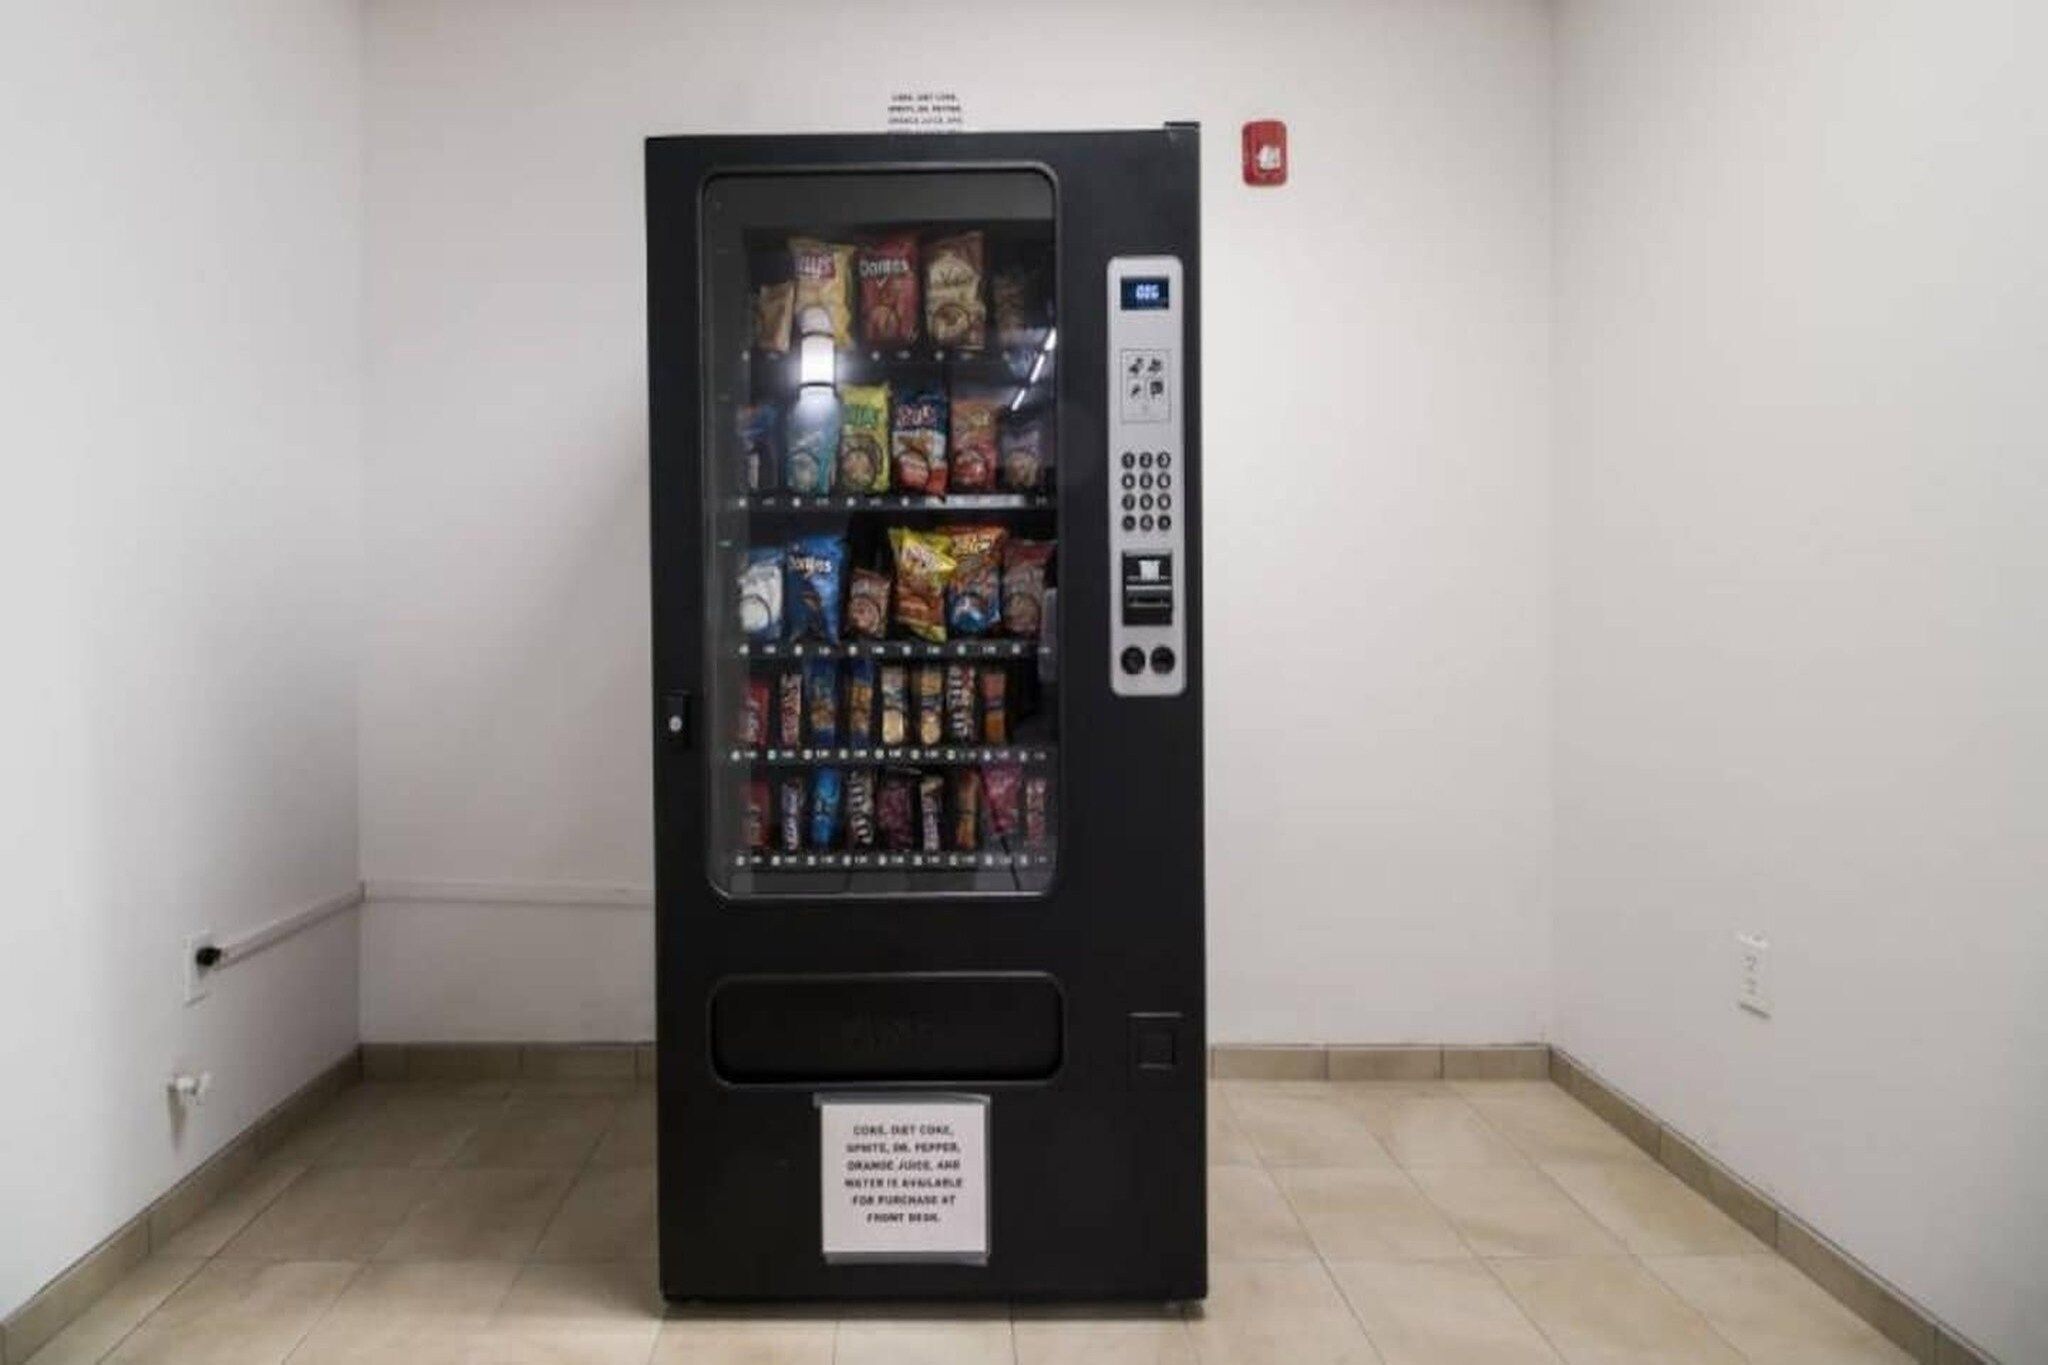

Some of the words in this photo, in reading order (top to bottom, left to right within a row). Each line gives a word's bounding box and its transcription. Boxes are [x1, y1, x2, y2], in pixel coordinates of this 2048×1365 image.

[891, 1125, 915, 1135] DIET
[919, 1125, 954, 1136] COKE,
[915, 1142, 961, 1152] PEPPER,
[847, 1160, 894, 1171] ORANGE
[898, 1160, 933, 1171] JUICE,
[937, 1160, 961, 1170] AND
[844, 1178, 884, 1188] WATER
[887, 1178, 898, 1188] IS
[902, 1178, 963, 1188] AVAILABLE
[852, 1195, 874, 1205] FOR
[878, 1195, 937, 1205] PURCHASE
[941, 1195, 956, 1205] AT
[866, 1213, 904, 1223] FRONT
[908, 1213, 941, 1223] DESK.
